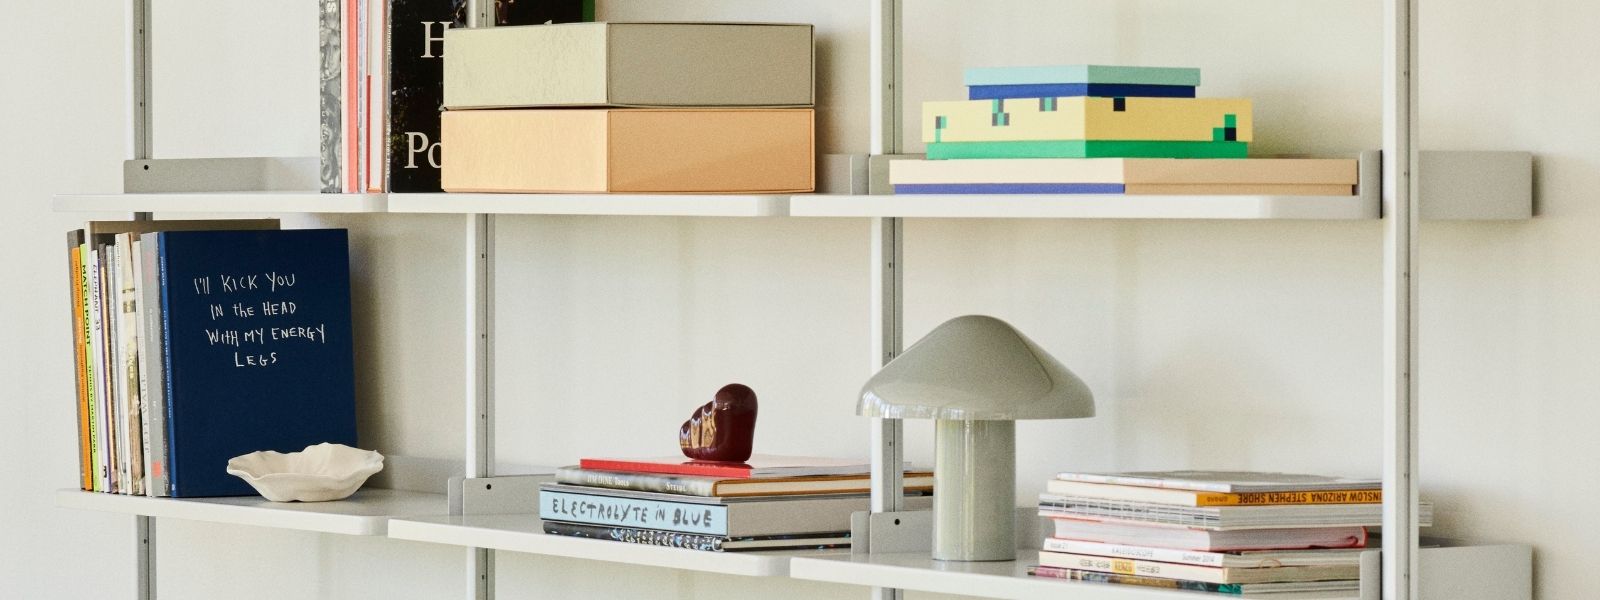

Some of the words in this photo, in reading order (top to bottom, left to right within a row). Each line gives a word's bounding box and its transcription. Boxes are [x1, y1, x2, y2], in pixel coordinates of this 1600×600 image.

[221, 274, 258, 292] KICK
[266, 272, 295, 292] YOU
[210, 304, 224, 320] IN
[262, 301, 296, 316] HEAD
[244, 328, 264, 344] MY
[272, 324, 325, 344] ENERGY
[598, 475, 612, 485] DINE
[1238, 492, 1266, 504] SHORE
[1268, 492, 1307, 504] STEPHEN
[1311, 491, 1347, 502] ARIZONA
[1350, 490, 1382, 502] INSLOW
[552, 498, 648, 524] ELECTROLYTE
[672, 508, 713, 528] BLUE
